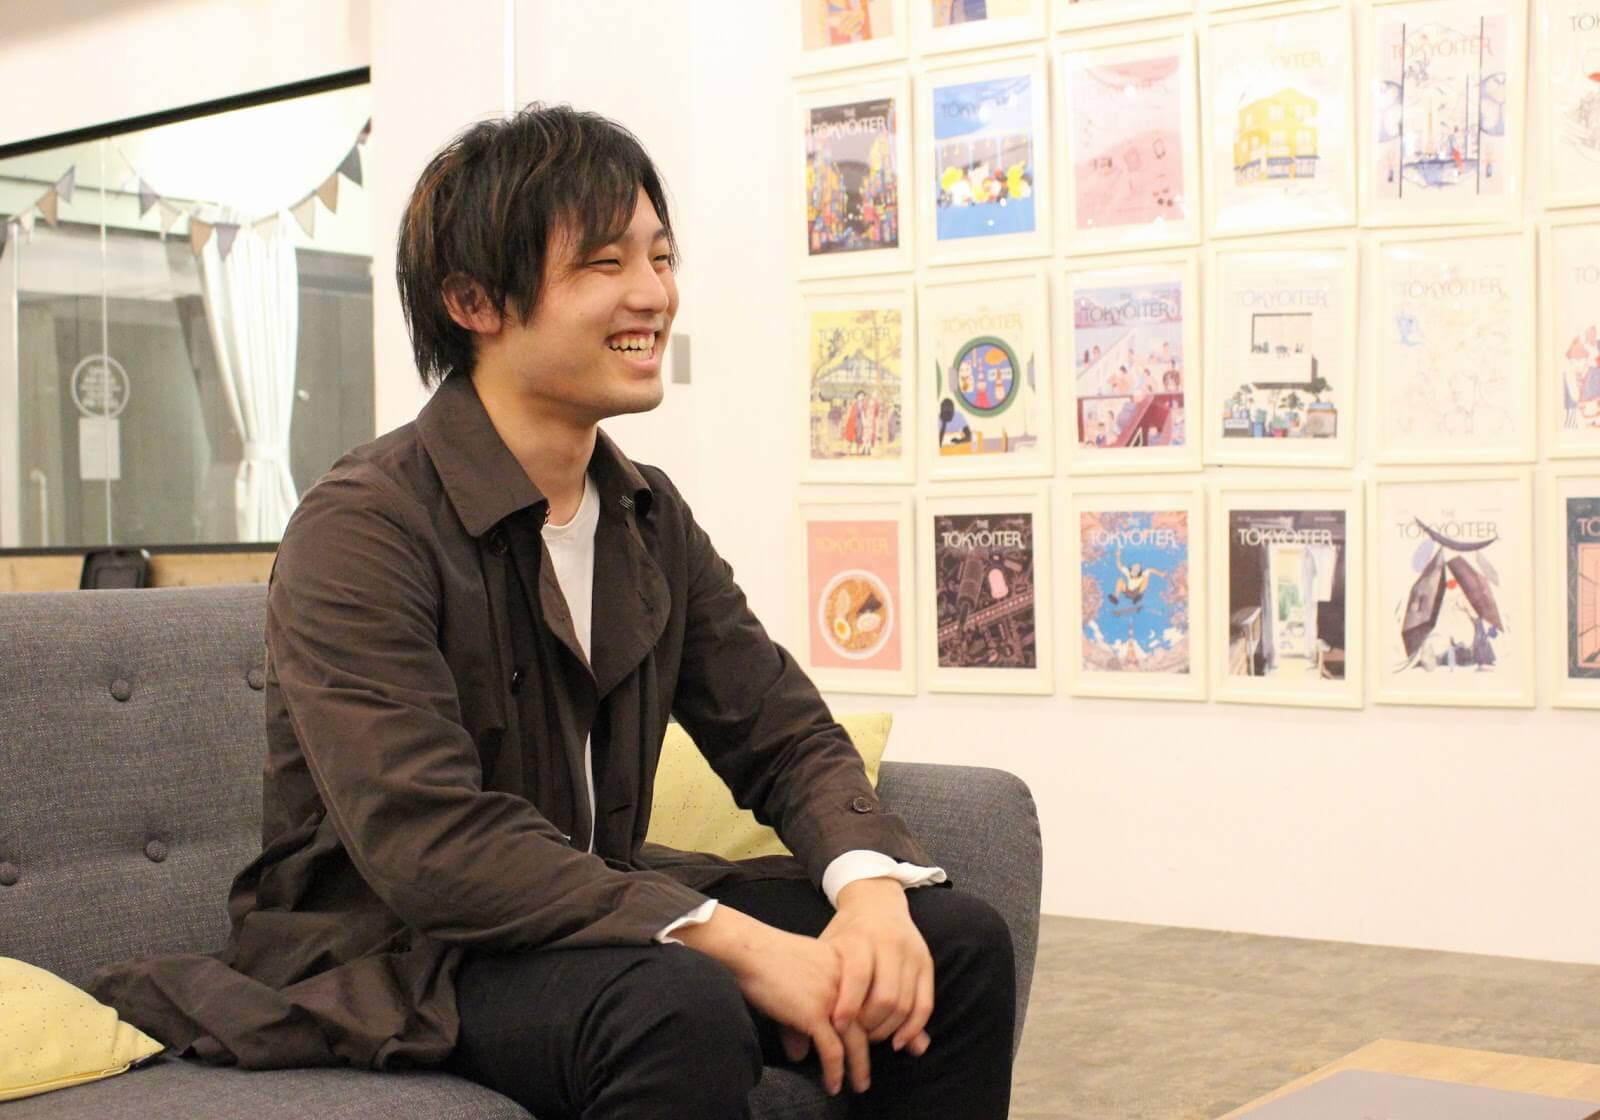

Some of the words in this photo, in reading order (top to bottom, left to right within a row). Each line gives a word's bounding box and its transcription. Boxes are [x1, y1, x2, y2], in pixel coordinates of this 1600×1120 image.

[941, 530, 1026, 551] TOKYOITER
[1089, 528, 1178, 549] TOKYOITER
[1237, 528, 1336, 550] TOKYOITER
